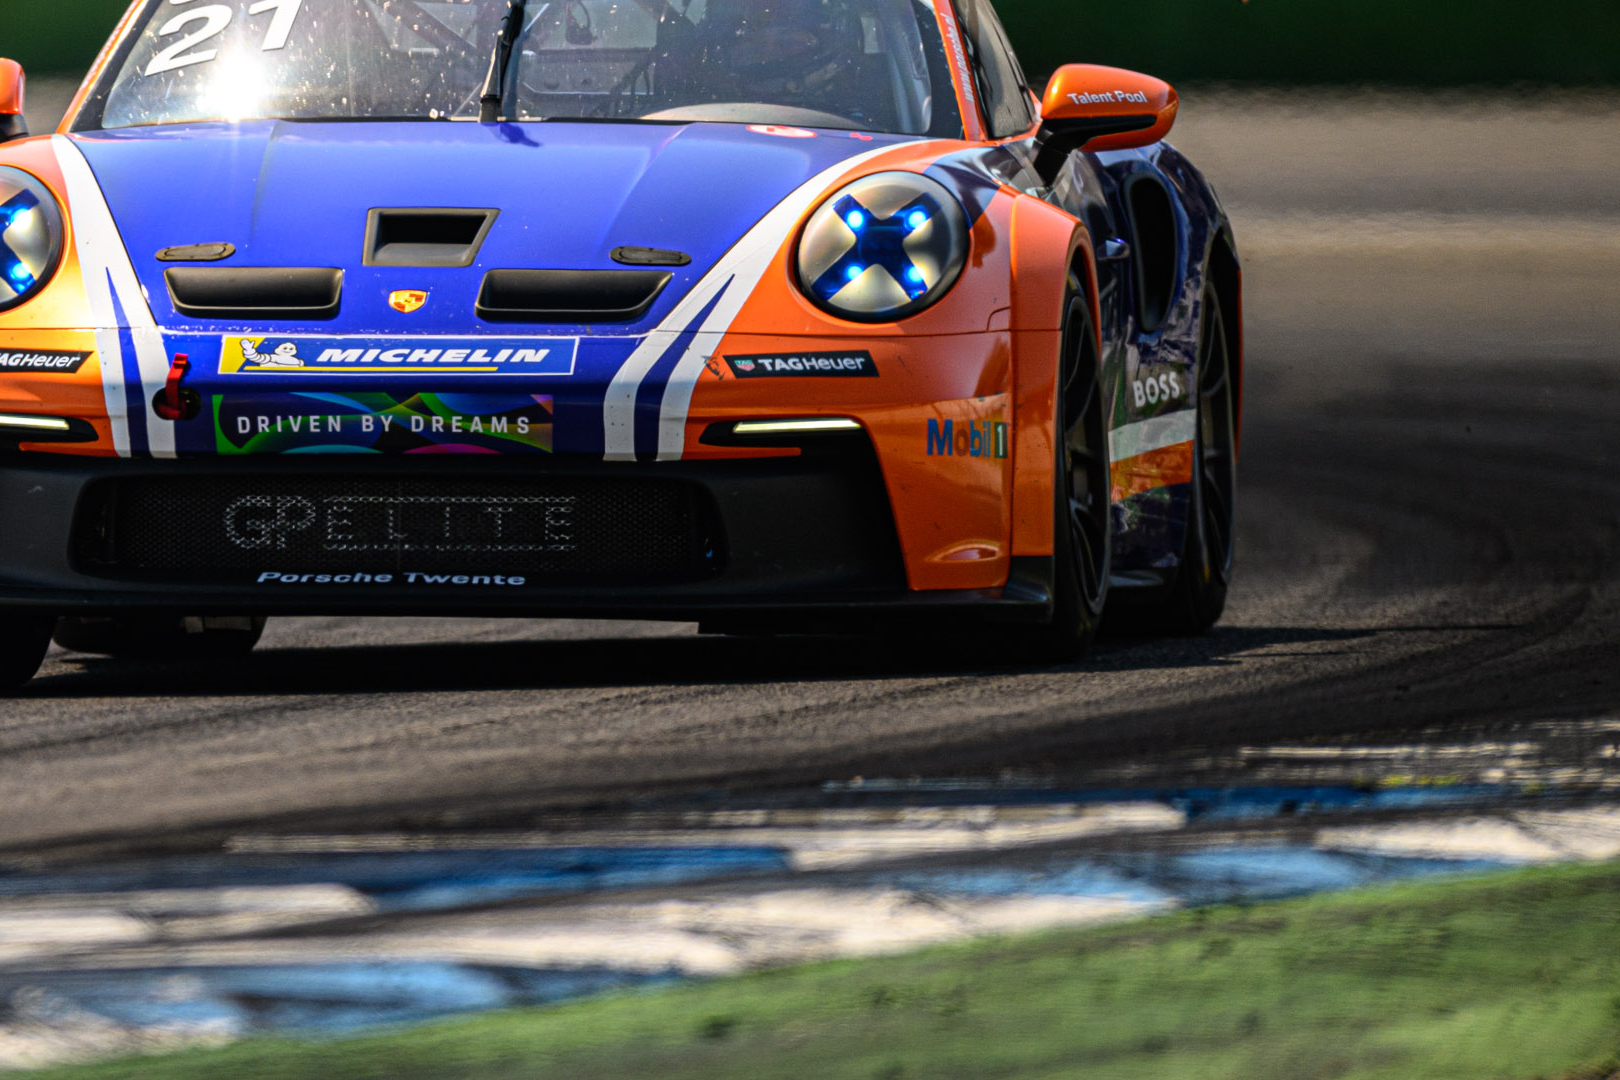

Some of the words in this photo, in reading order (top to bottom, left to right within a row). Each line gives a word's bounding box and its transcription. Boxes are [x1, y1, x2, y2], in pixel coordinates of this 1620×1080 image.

[1067, 90, 1116, 105] Talent
[1113, 90, 1148, 104] Pool
[316, 348, 551, 364] MICHELIN
[1132, 371, 1181, 408] BOSS
[237, 414, 342, 435] DRIVEN
[361, 414, 394, 433] BY
[410, 414, 531, 435] DREAMS
[926, 417, 992, 458] Mobil
[256, 571, 394, 584] Porsche
[403, 571, 526, 586] Twente
